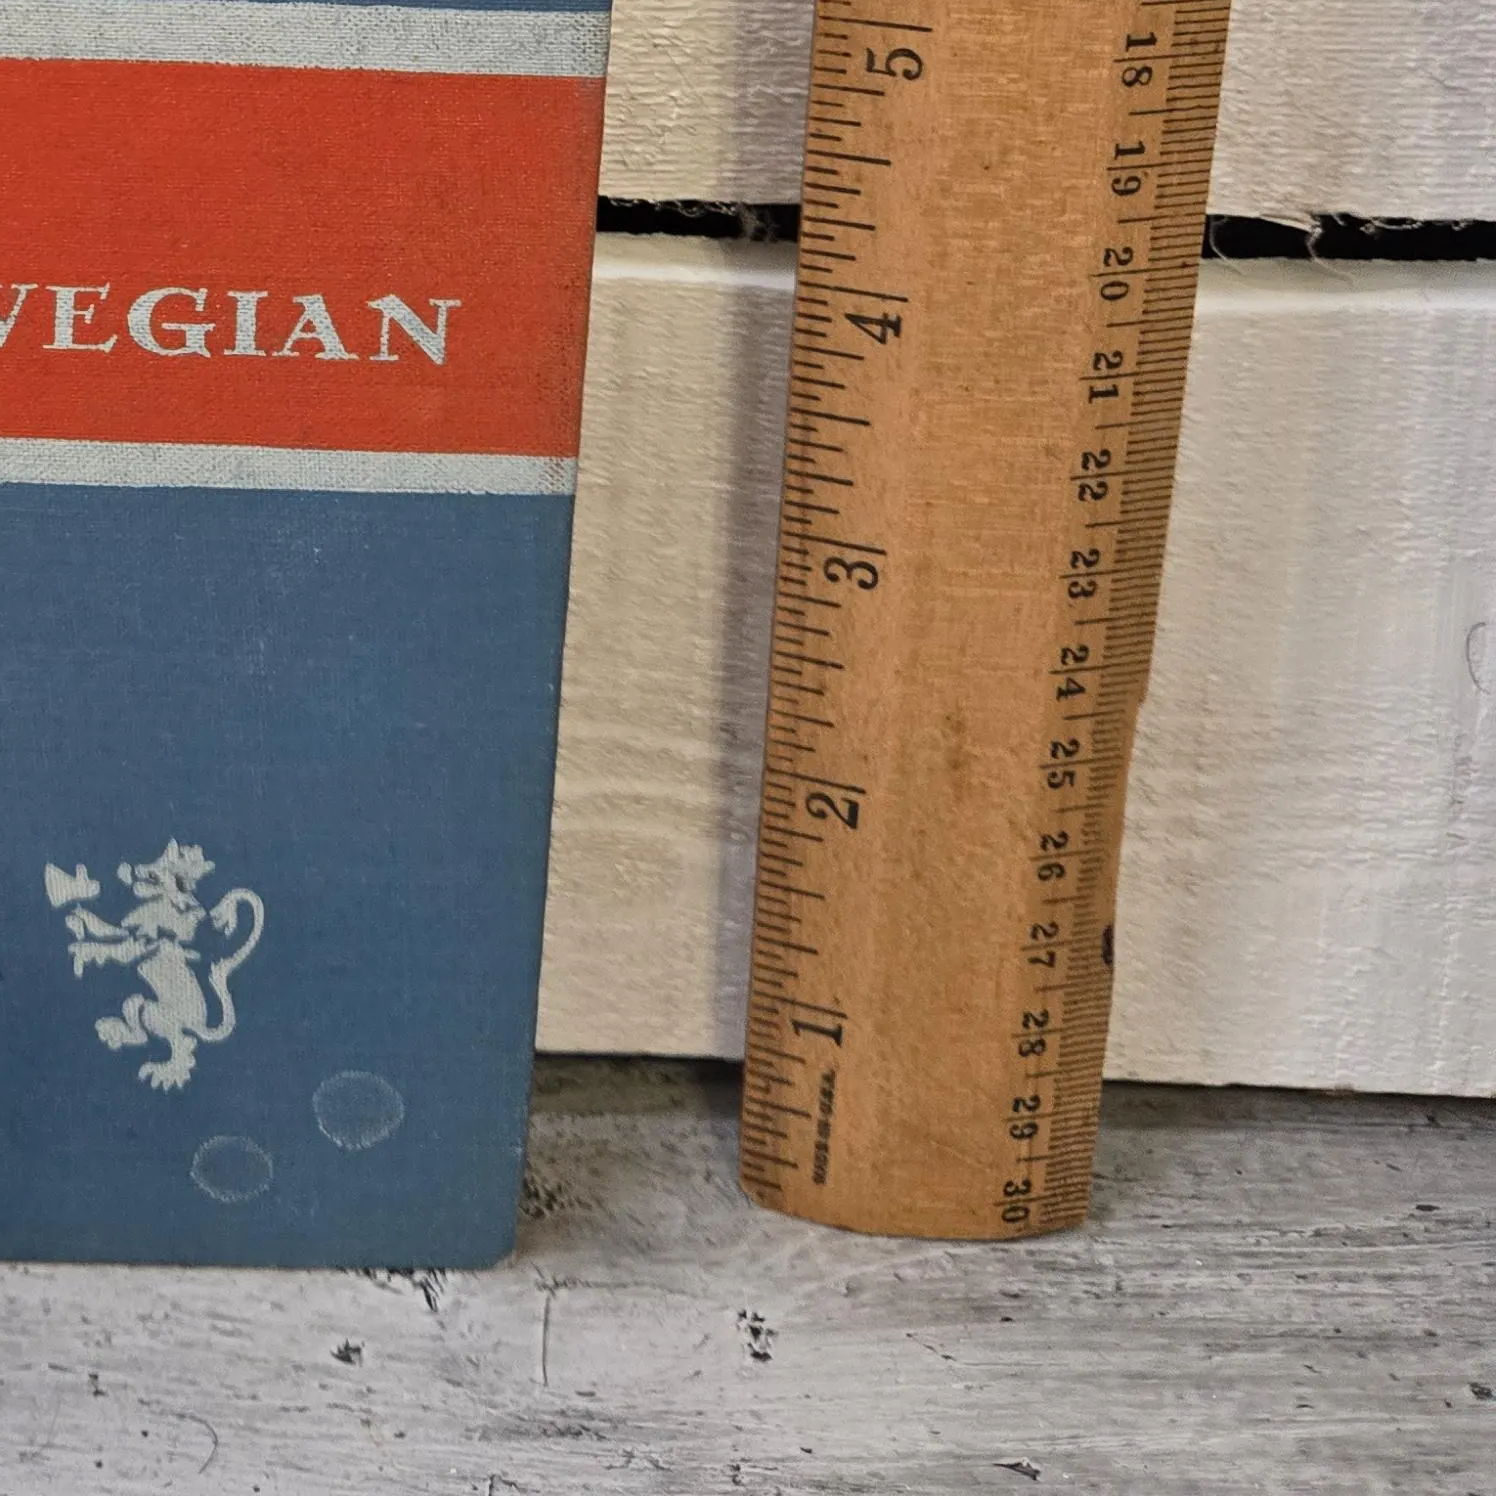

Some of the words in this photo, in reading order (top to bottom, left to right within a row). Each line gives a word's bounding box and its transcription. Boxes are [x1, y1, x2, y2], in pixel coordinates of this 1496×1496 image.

[866, 48, 923, 81] 5
[1121, 31, 1157, 88] 18
[1111, 140, 1146, 197] 19
[1100, 247, 1134, 301] 20
[844, 312, 902, 345] 4
[1088, 350, 1124, 404] 21
[1077, 448, 1112, 503] 22
[823, 556, 879, 590] 3
[1068, 548, 1101, 600] 23
[1056, 645, 1090, 699] 24
[1047, 738, 1081, 790] 25
[805, 791, 861, 830] 2
[1037, 830, 1070, 882] 26
[1028, 922, 1059, 969] 27
[790, 1018, 843, 1049] 1
[1018, 1009, 1050, 1058] 28
[1009, 1094, 1042, 1141] 29
[1001, 1178, 1032, 1225] 30
